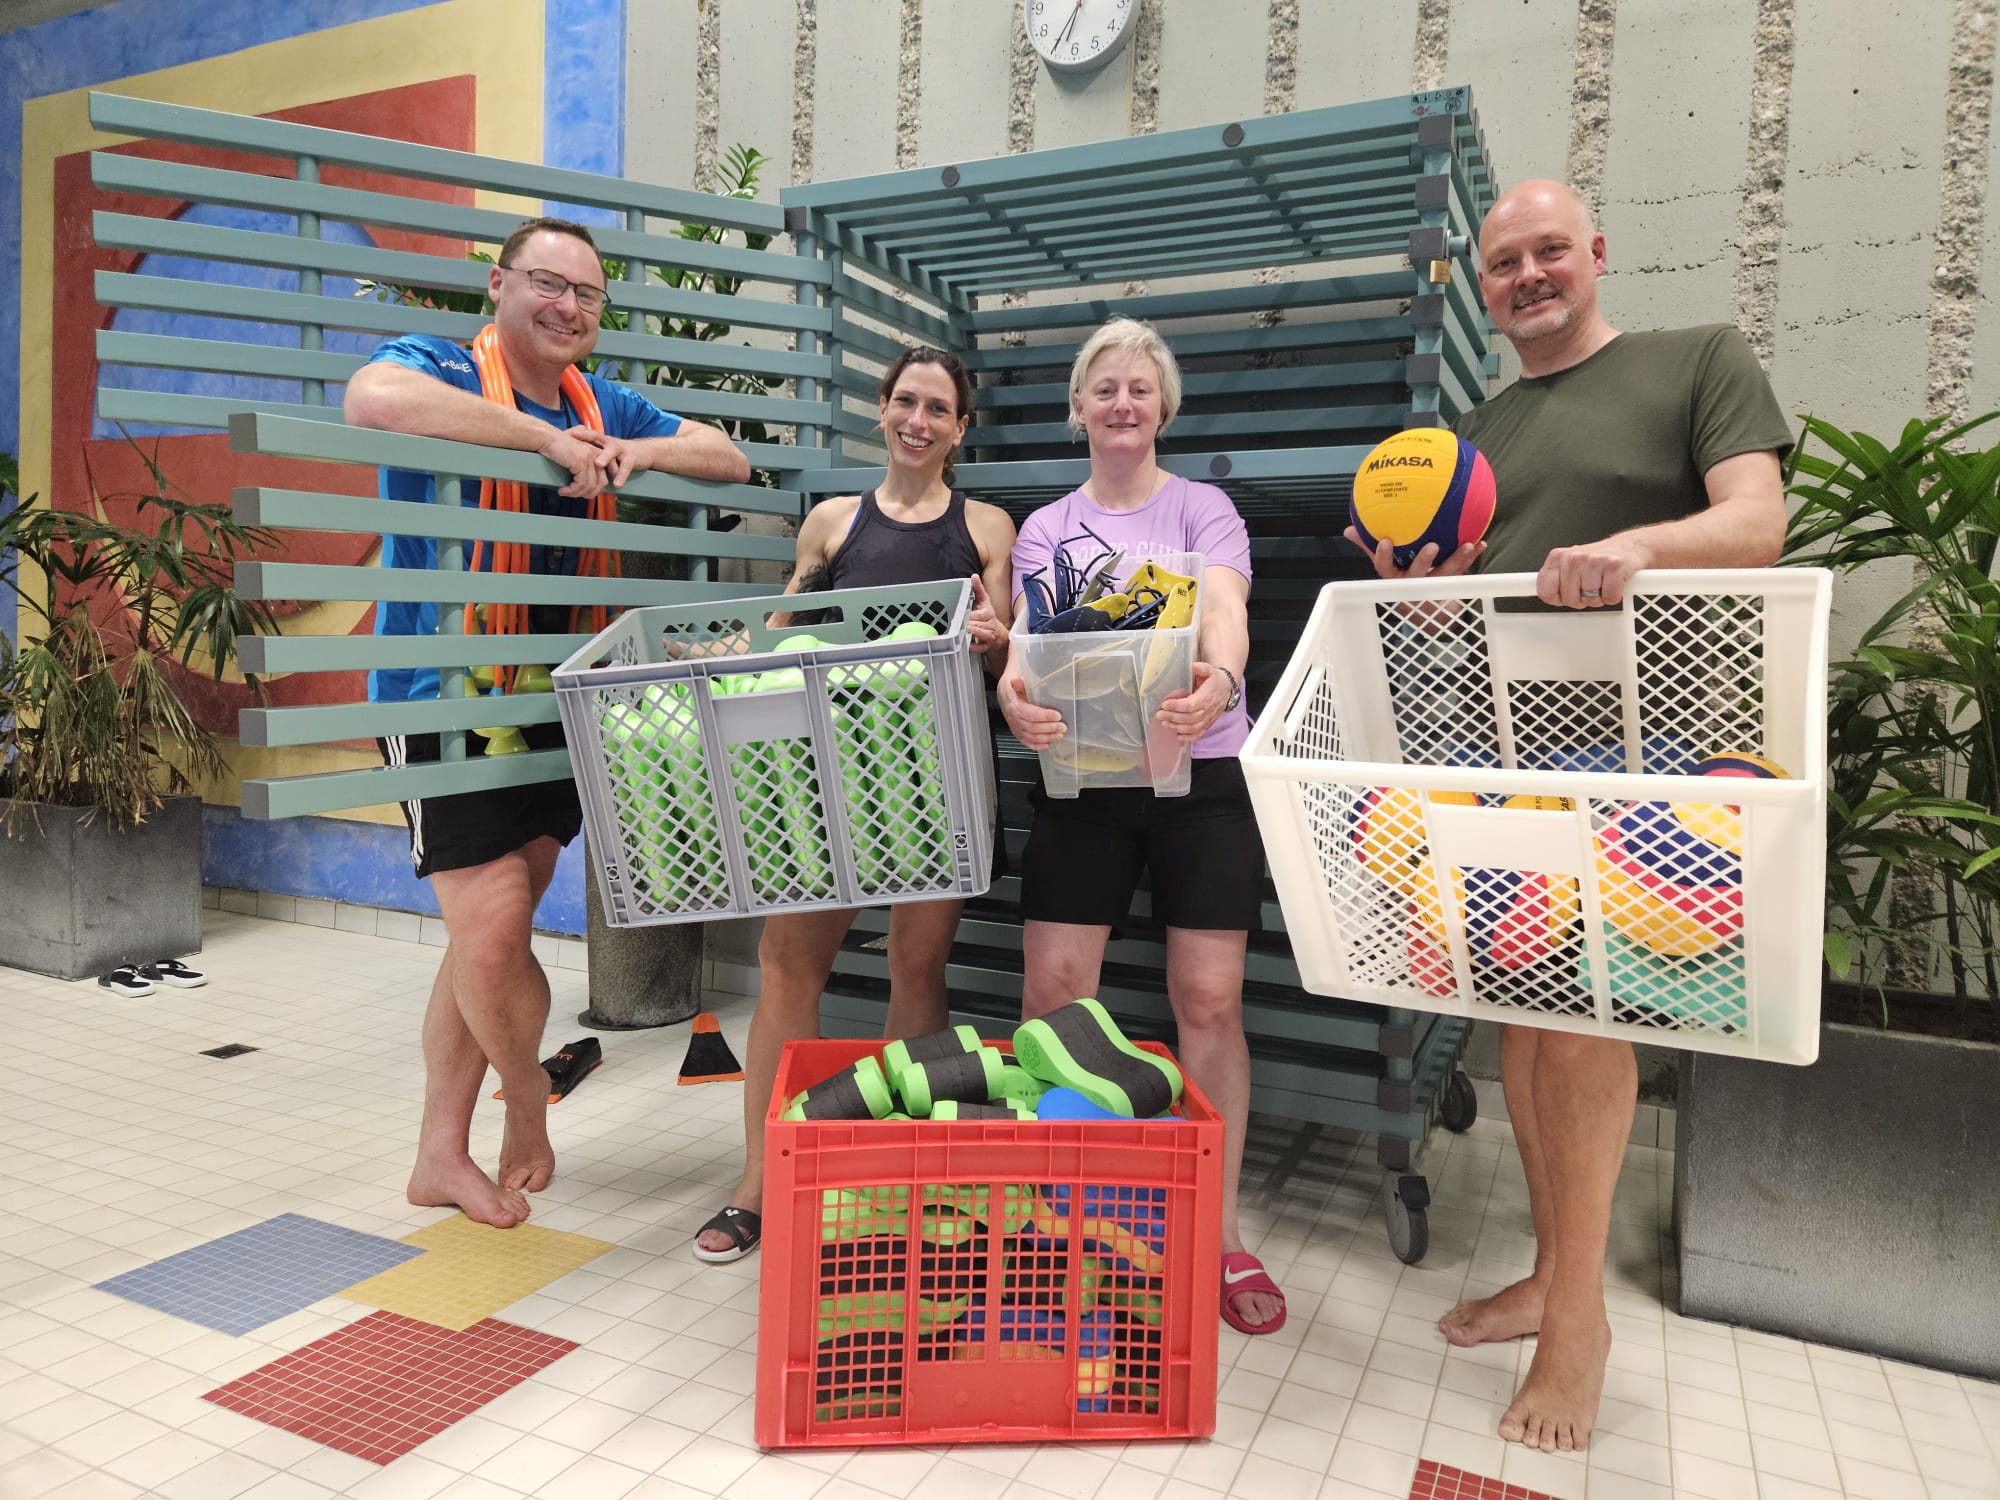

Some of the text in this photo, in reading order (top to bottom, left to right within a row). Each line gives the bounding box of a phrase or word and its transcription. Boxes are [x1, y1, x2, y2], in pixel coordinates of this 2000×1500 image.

[1035, 3, 1044, 15] 9
[1040, 24, 1048, 37] 8
[1107, 18, 1115, 32] 4
[1071, 42, 1079, 56] 6
[1090, 36, 1099, 49] 5
